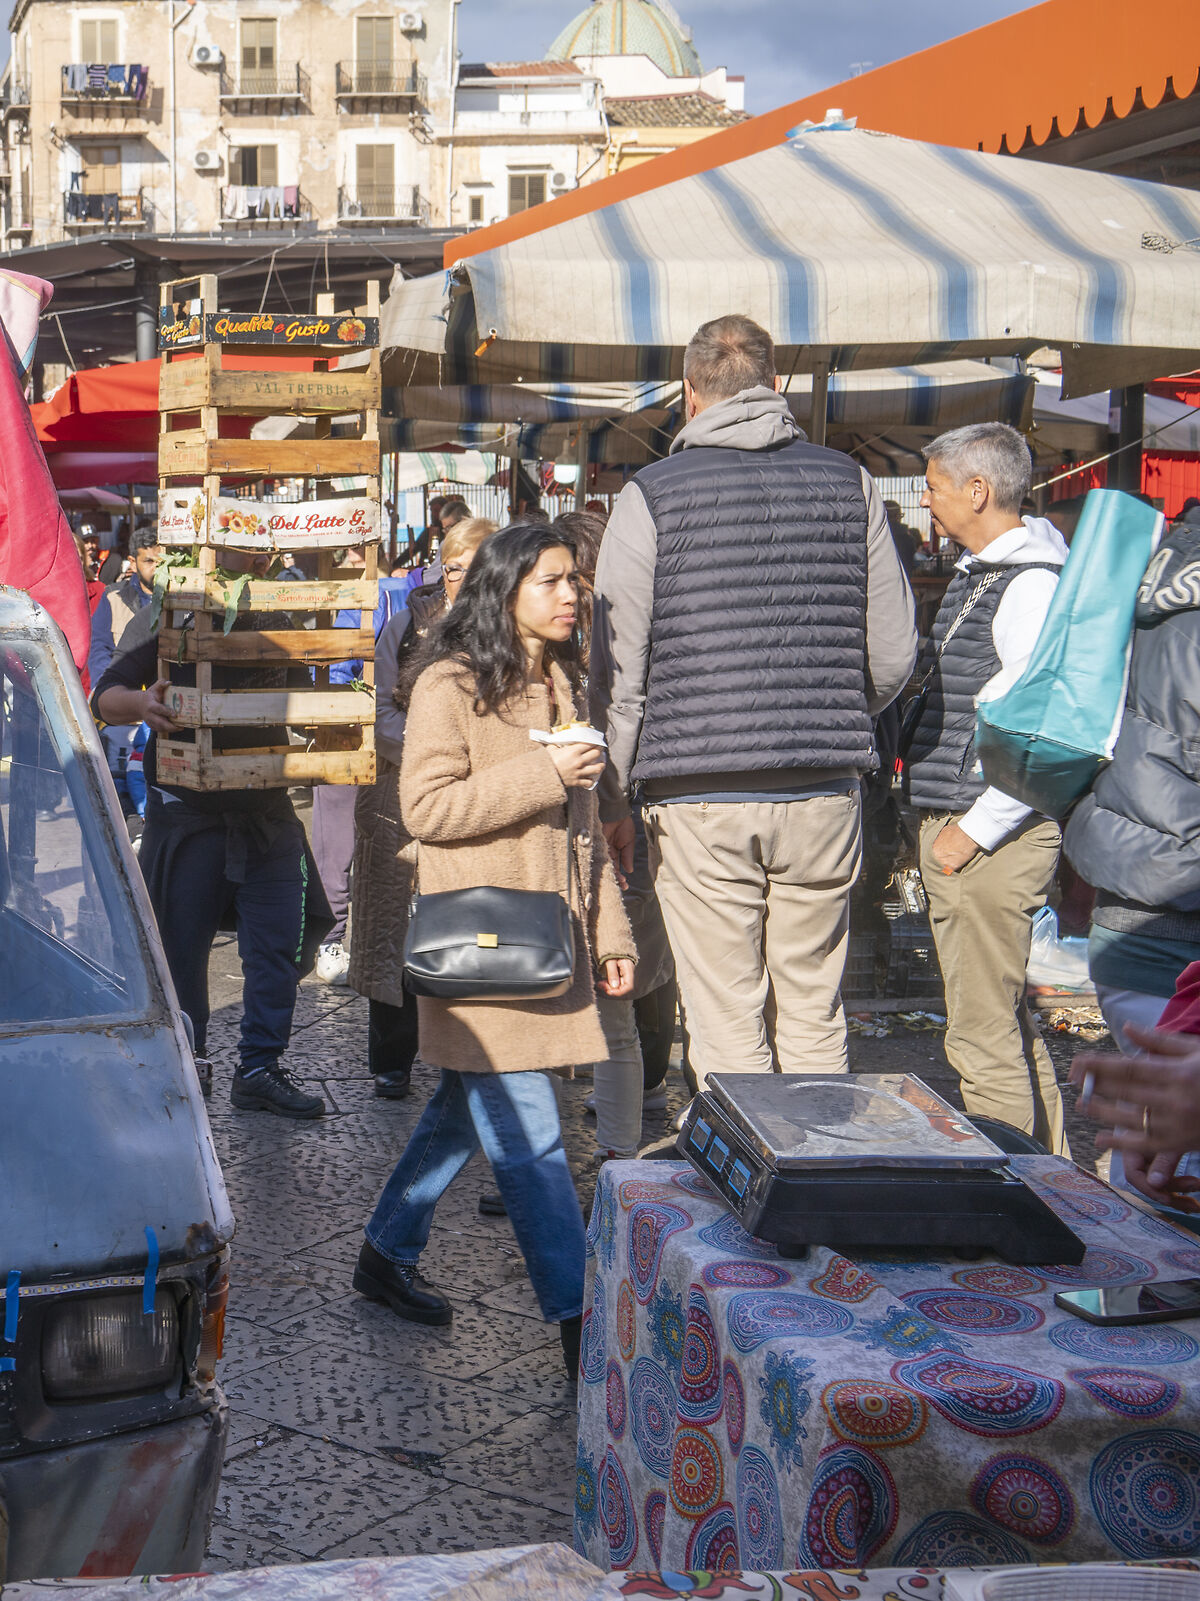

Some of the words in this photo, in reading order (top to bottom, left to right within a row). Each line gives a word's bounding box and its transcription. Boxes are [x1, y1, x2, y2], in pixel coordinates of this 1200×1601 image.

[215, 314, 275, 336] Qualità
[274, 323, 285, 333] e
[285, 319, 330, 342] Gusto
[255, 383, 281, 394] VAL
[286, 384, 349, 395] TREBBIA
[270, 514, 300, 530] Del
[299, 513, 347, 532] Latte
[349, 509, 366, 526] G.
